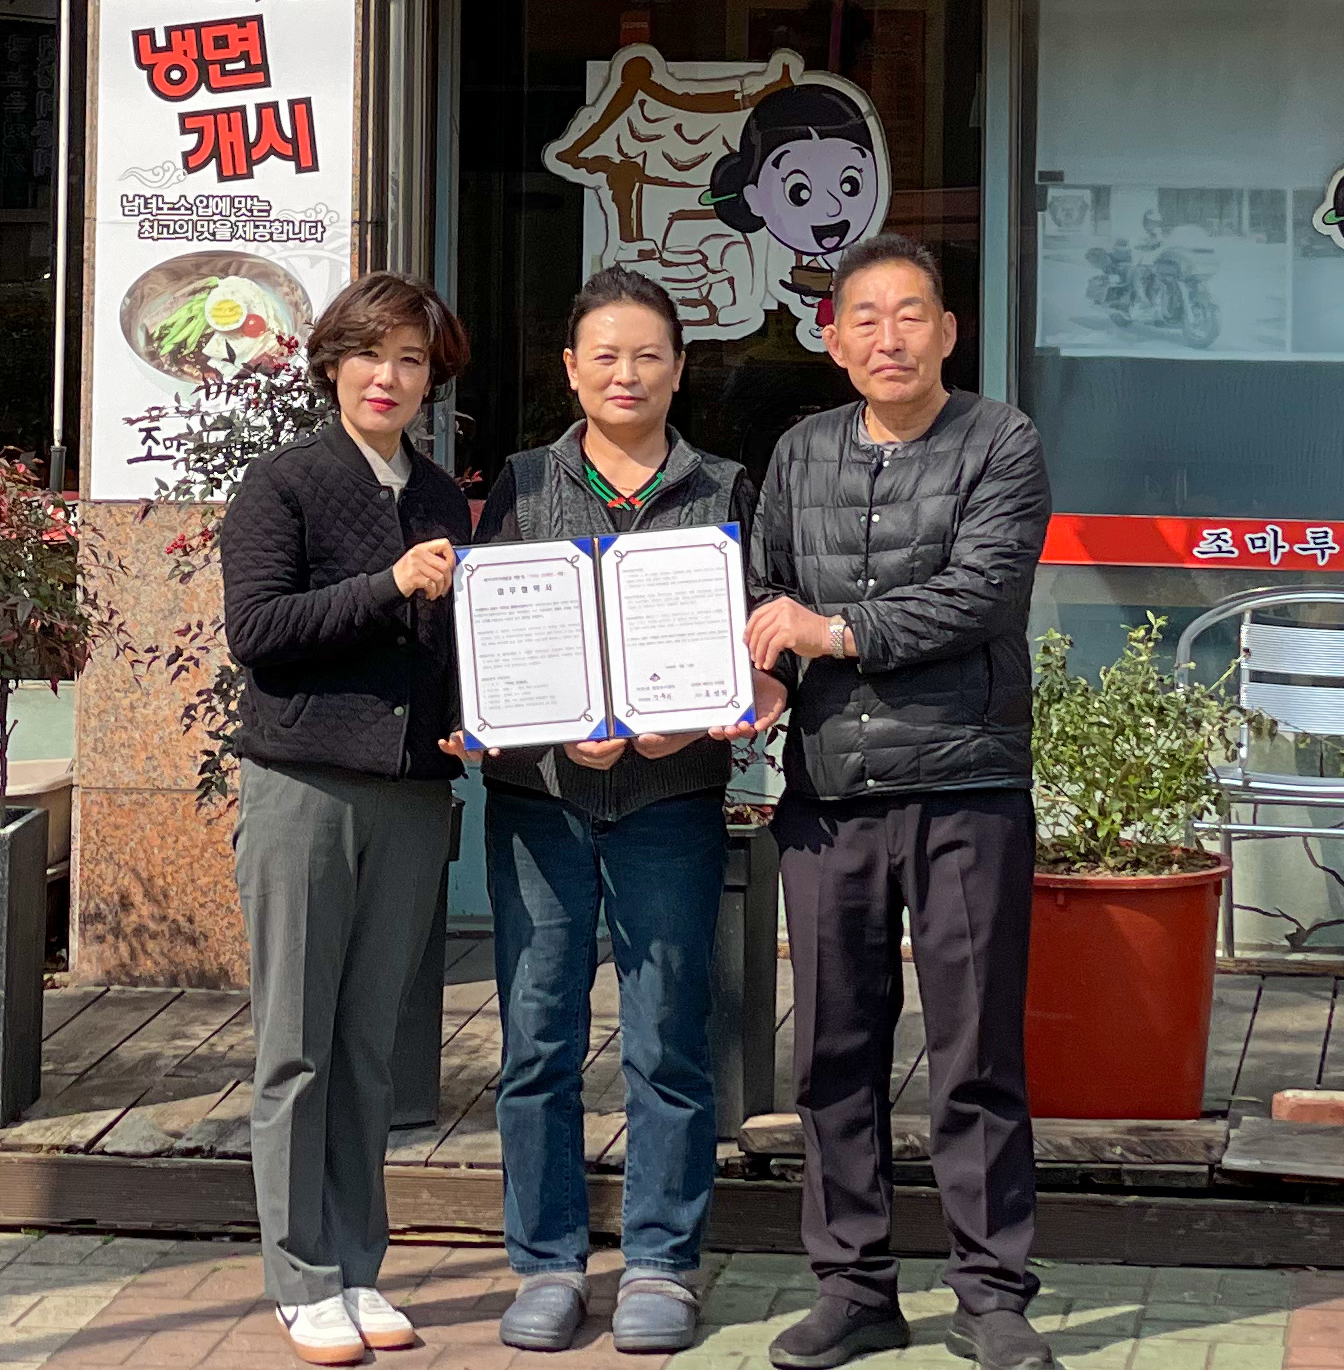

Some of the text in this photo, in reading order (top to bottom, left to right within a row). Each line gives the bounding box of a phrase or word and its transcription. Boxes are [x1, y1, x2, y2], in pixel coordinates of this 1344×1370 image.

[131, 14, 272, 103] 냉면
[177, 96, 320, 184] 개시
[121, 194, 193, 217] 남녀노소
[194, 195, 232, 218] 입에
[138, 218, 326, 243] 최고의 맛을 제공합니다
